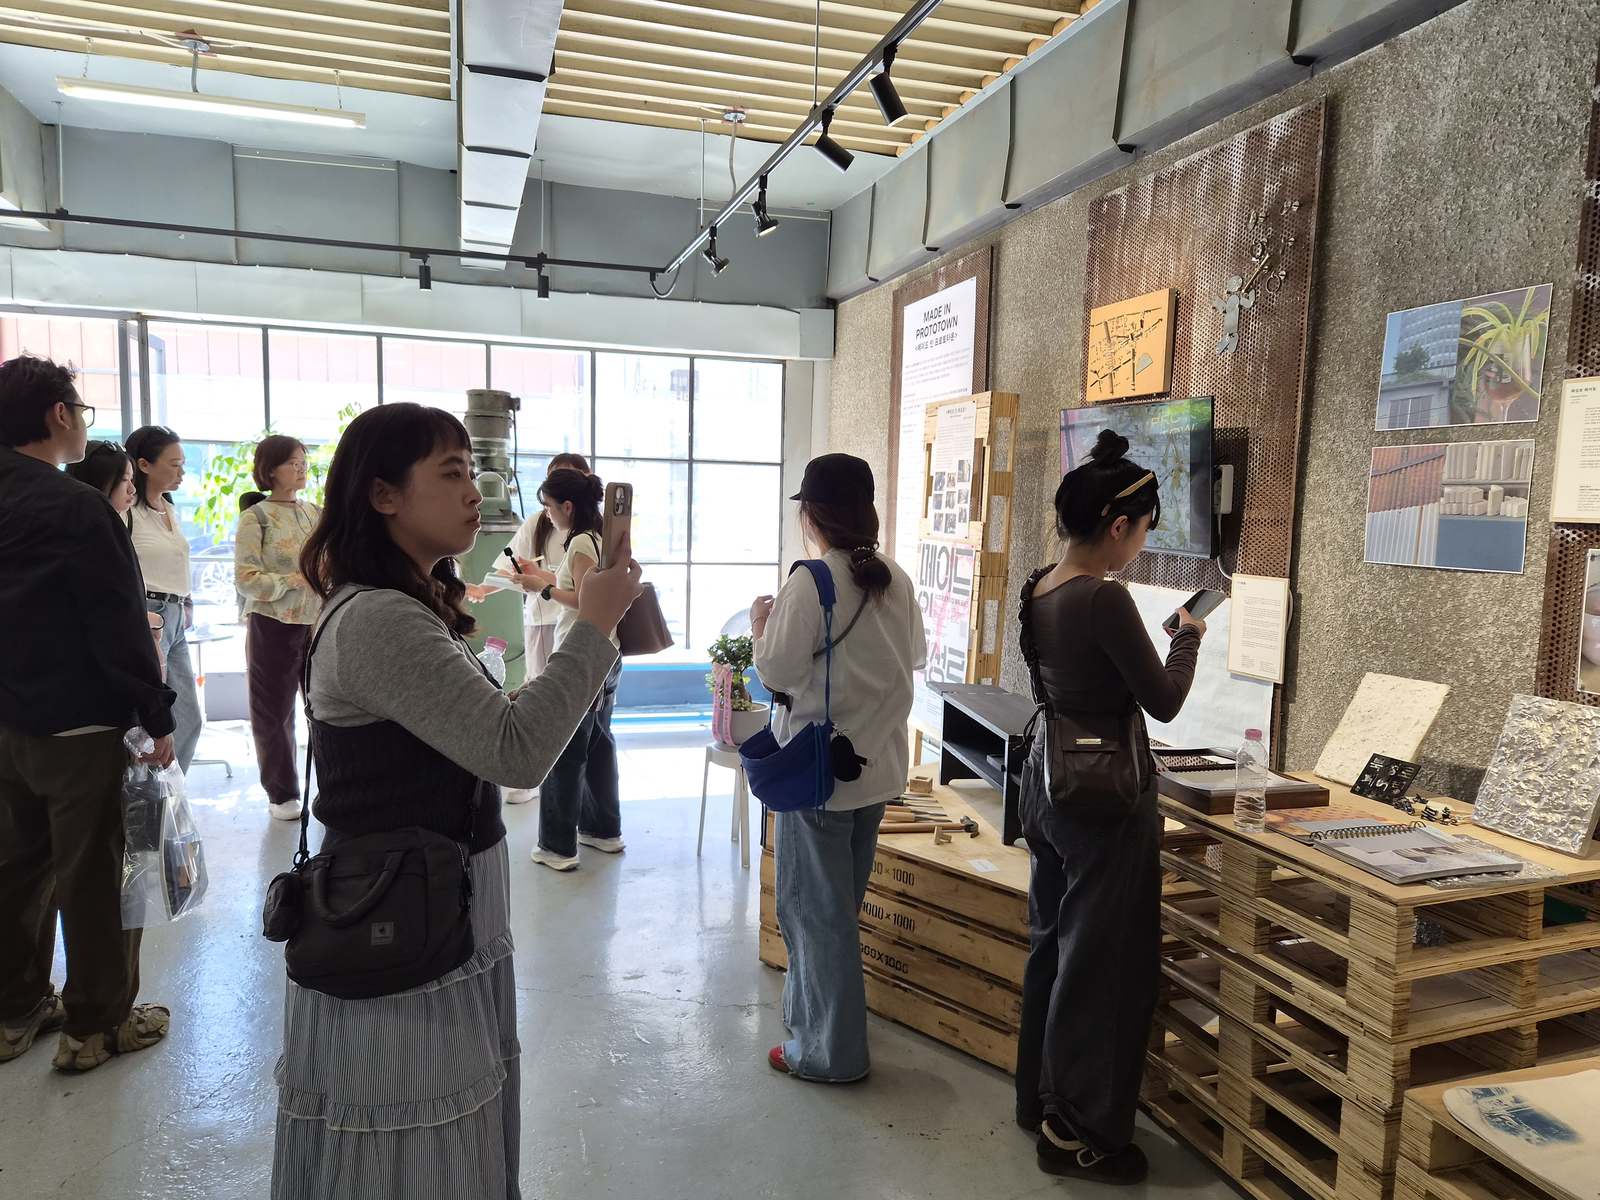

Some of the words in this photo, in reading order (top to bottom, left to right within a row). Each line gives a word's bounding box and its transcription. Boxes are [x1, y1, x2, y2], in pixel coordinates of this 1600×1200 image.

[923, 305, 943, 322] MADE
[944, 303, 951, 314] IN
[915, 315, 958, 340] PROTOTOWN
[919, 543, 973, 596] 메이드
[893, 868, 914, 885] 1000
[893, 913, 915, 932] 1000
